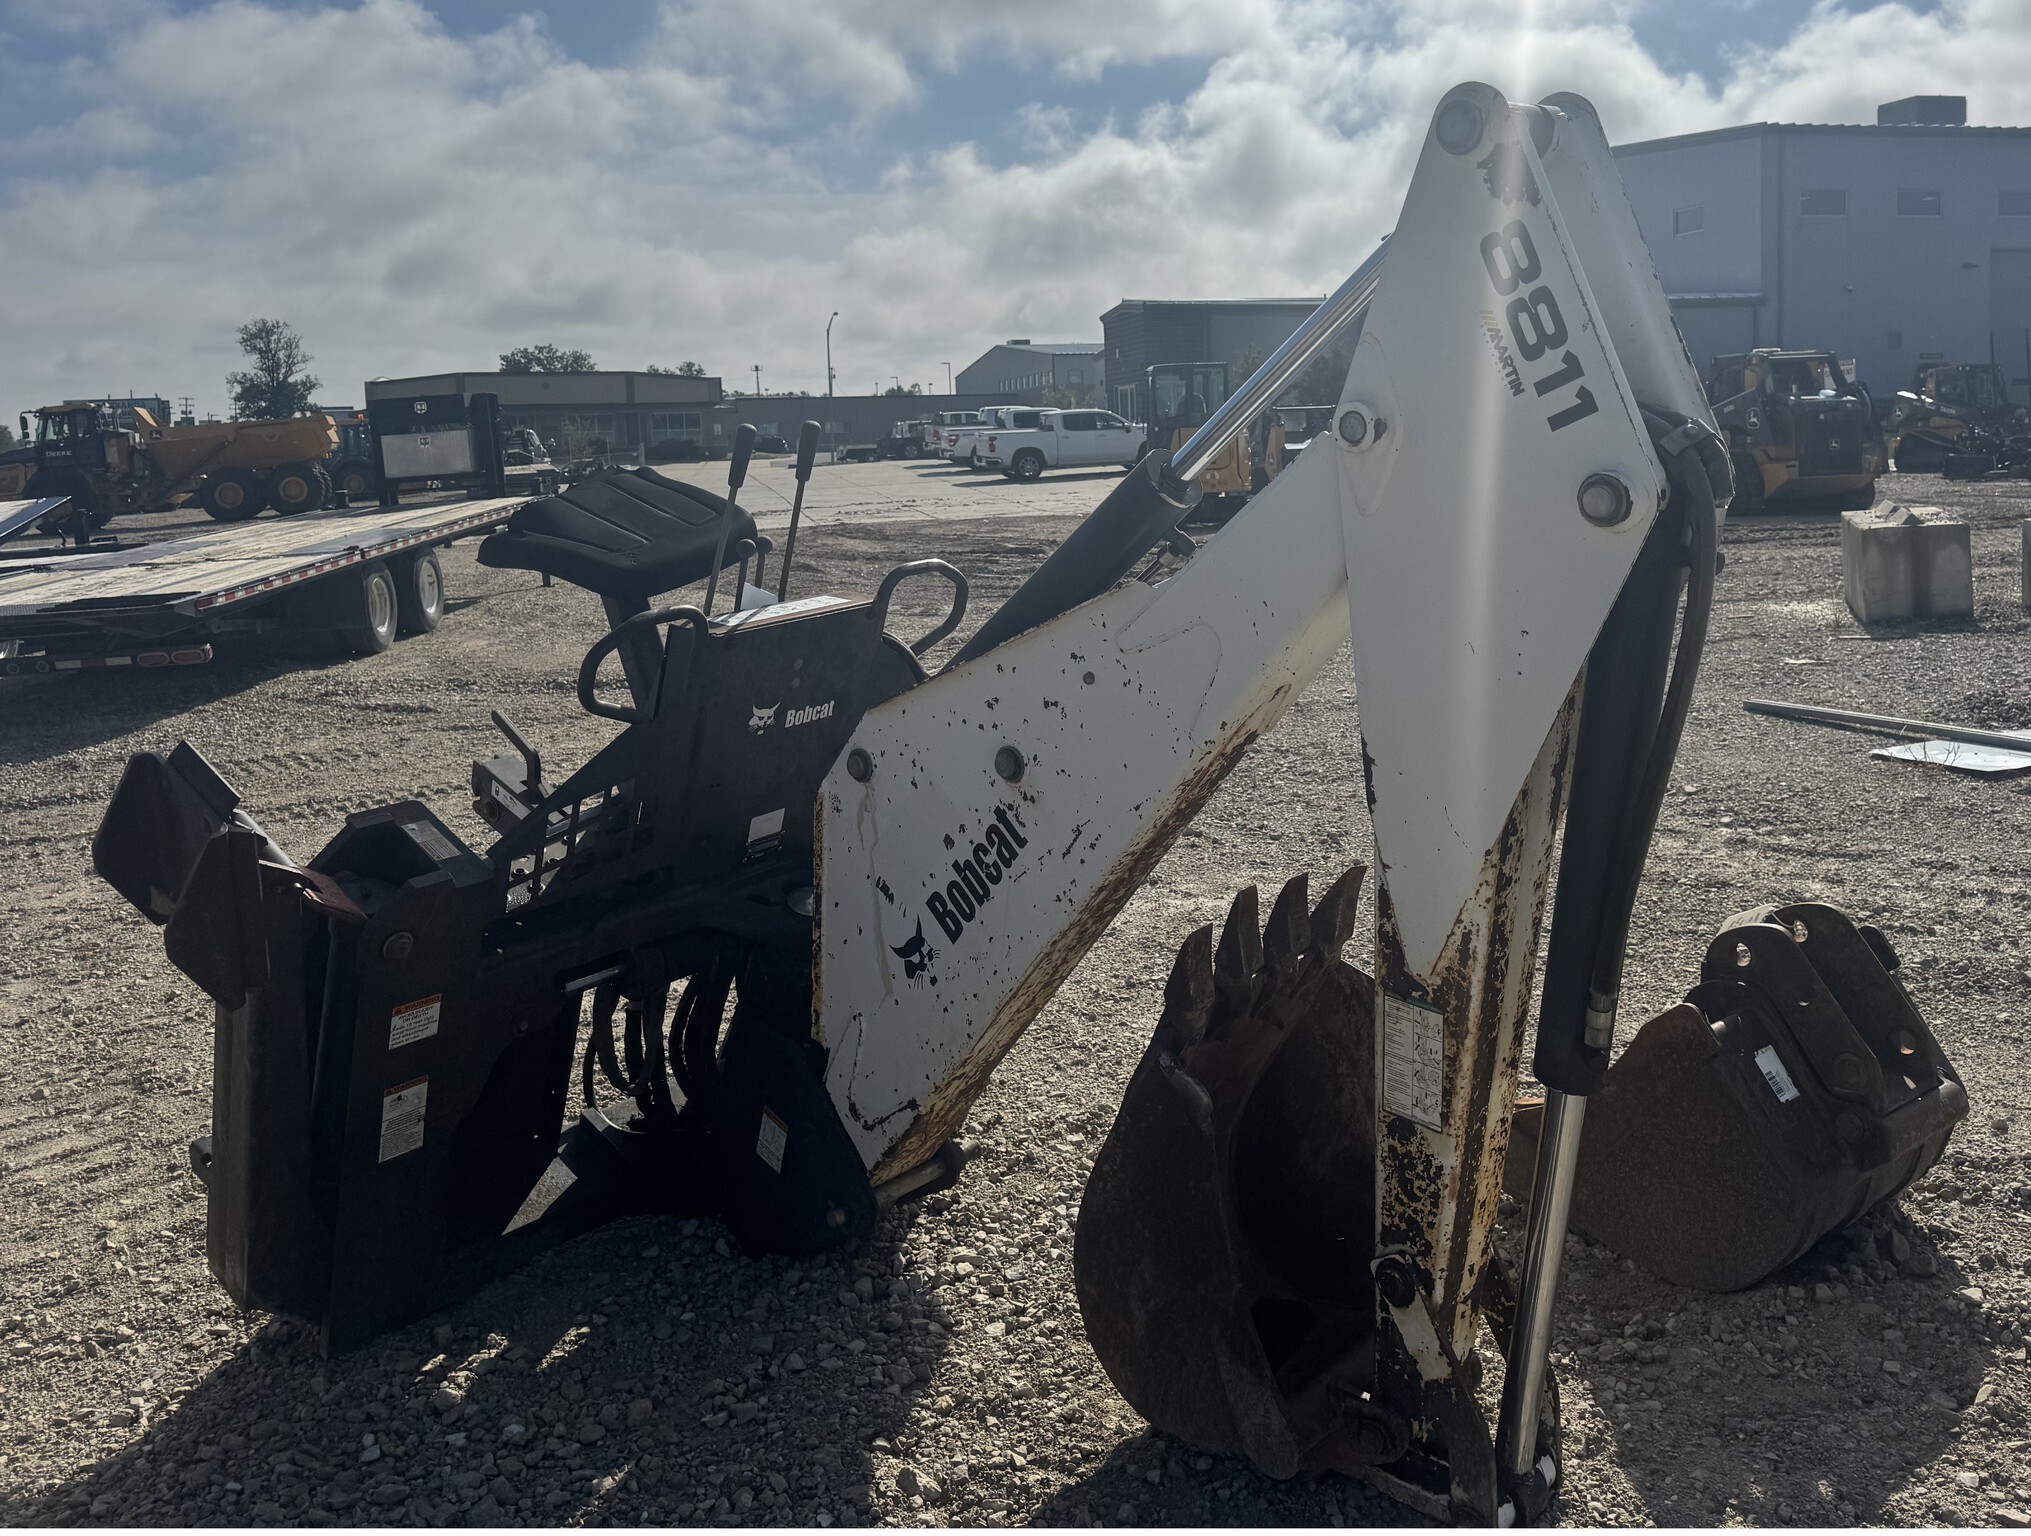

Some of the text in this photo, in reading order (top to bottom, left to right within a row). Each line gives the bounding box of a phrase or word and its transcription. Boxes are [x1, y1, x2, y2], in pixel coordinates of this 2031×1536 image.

[1479, 219, 1599, 433] 8811
[1486, 327, 1526, 397] MARTIN
[784, 700, 835, 728] Bobcat
[925, 805, 1029, 945] Bobcat
